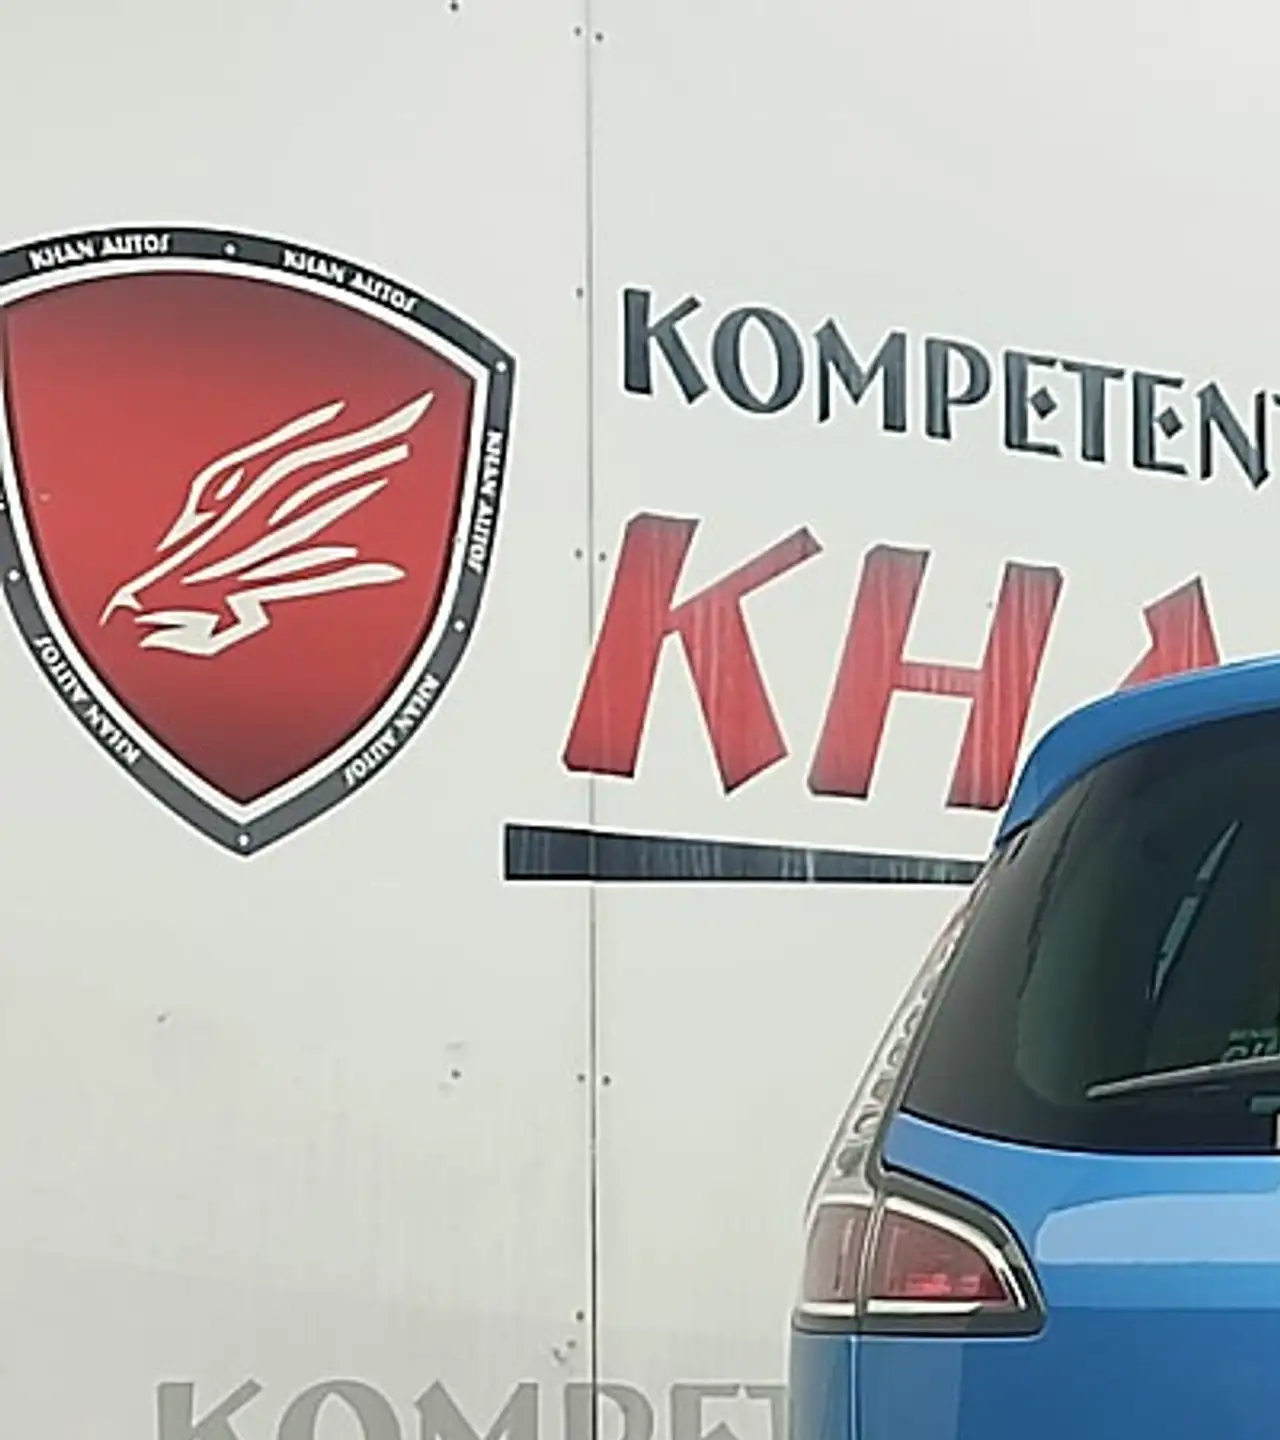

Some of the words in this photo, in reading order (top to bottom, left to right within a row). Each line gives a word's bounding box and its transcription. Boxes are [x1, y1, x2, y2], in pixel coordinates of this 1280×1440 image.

[29, 235, 96, 270] KHAN
[99, 233, 170, 257] AUTOS
[282, 248, 346, 285] KHAN
[348, 273, 418, 314] AUTOS
